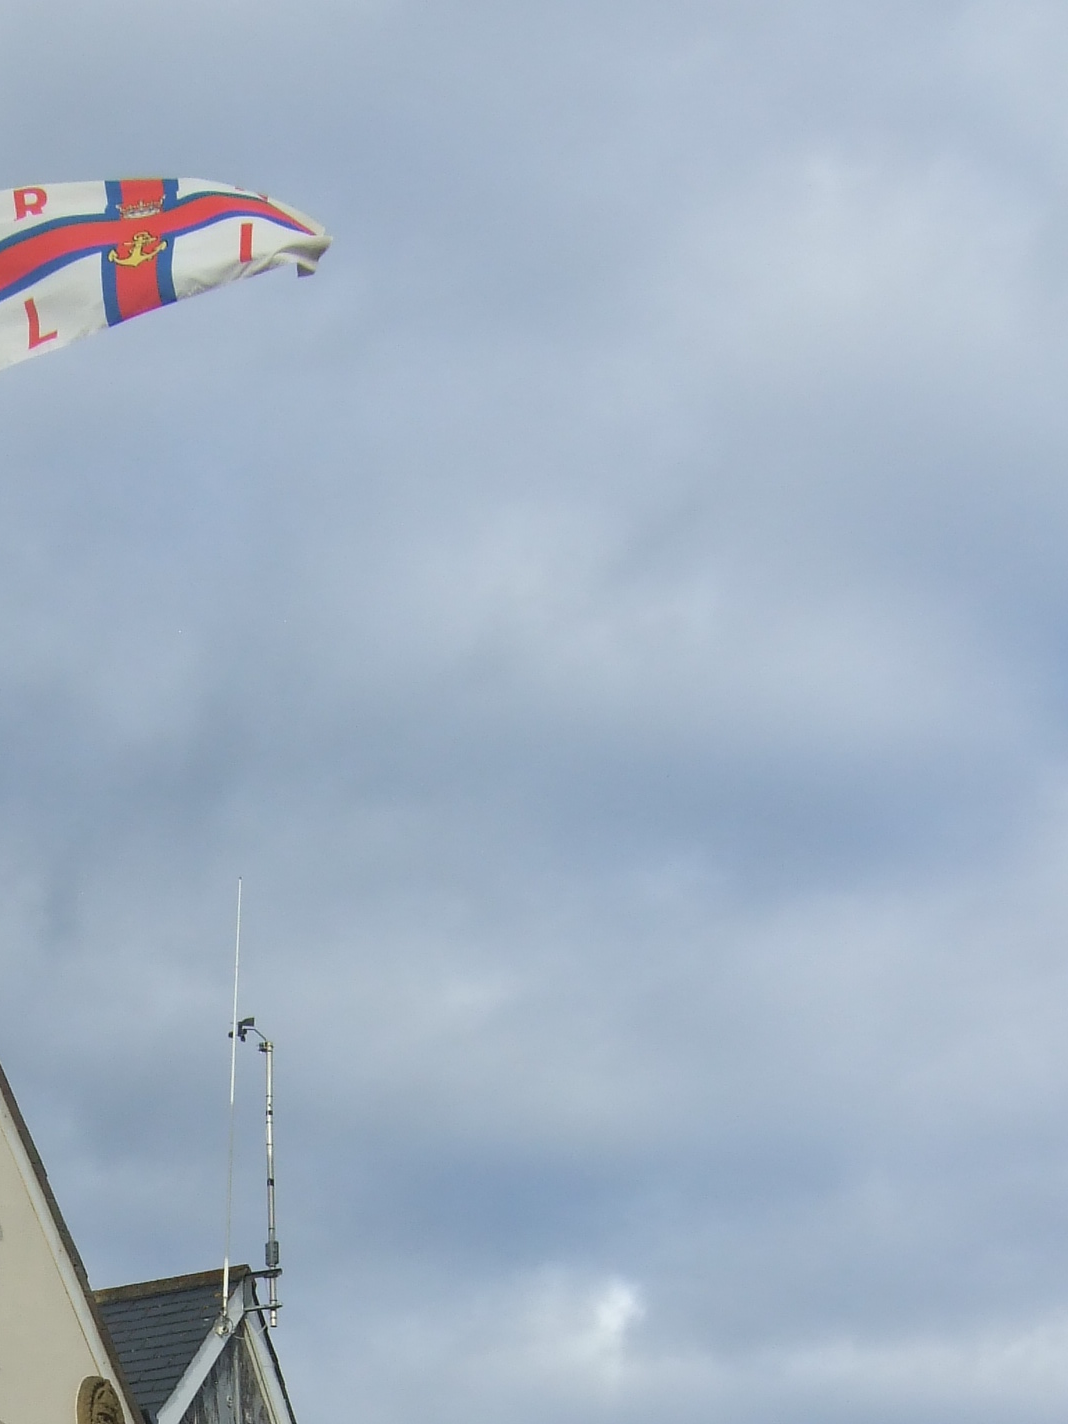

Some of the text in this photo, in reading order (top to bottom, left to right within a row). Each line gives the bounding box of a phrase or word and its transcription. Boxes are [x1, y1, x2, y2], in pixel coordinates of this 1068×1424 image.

[13, 187, 47, 221] R
[24, 223, 254, 349] L I
